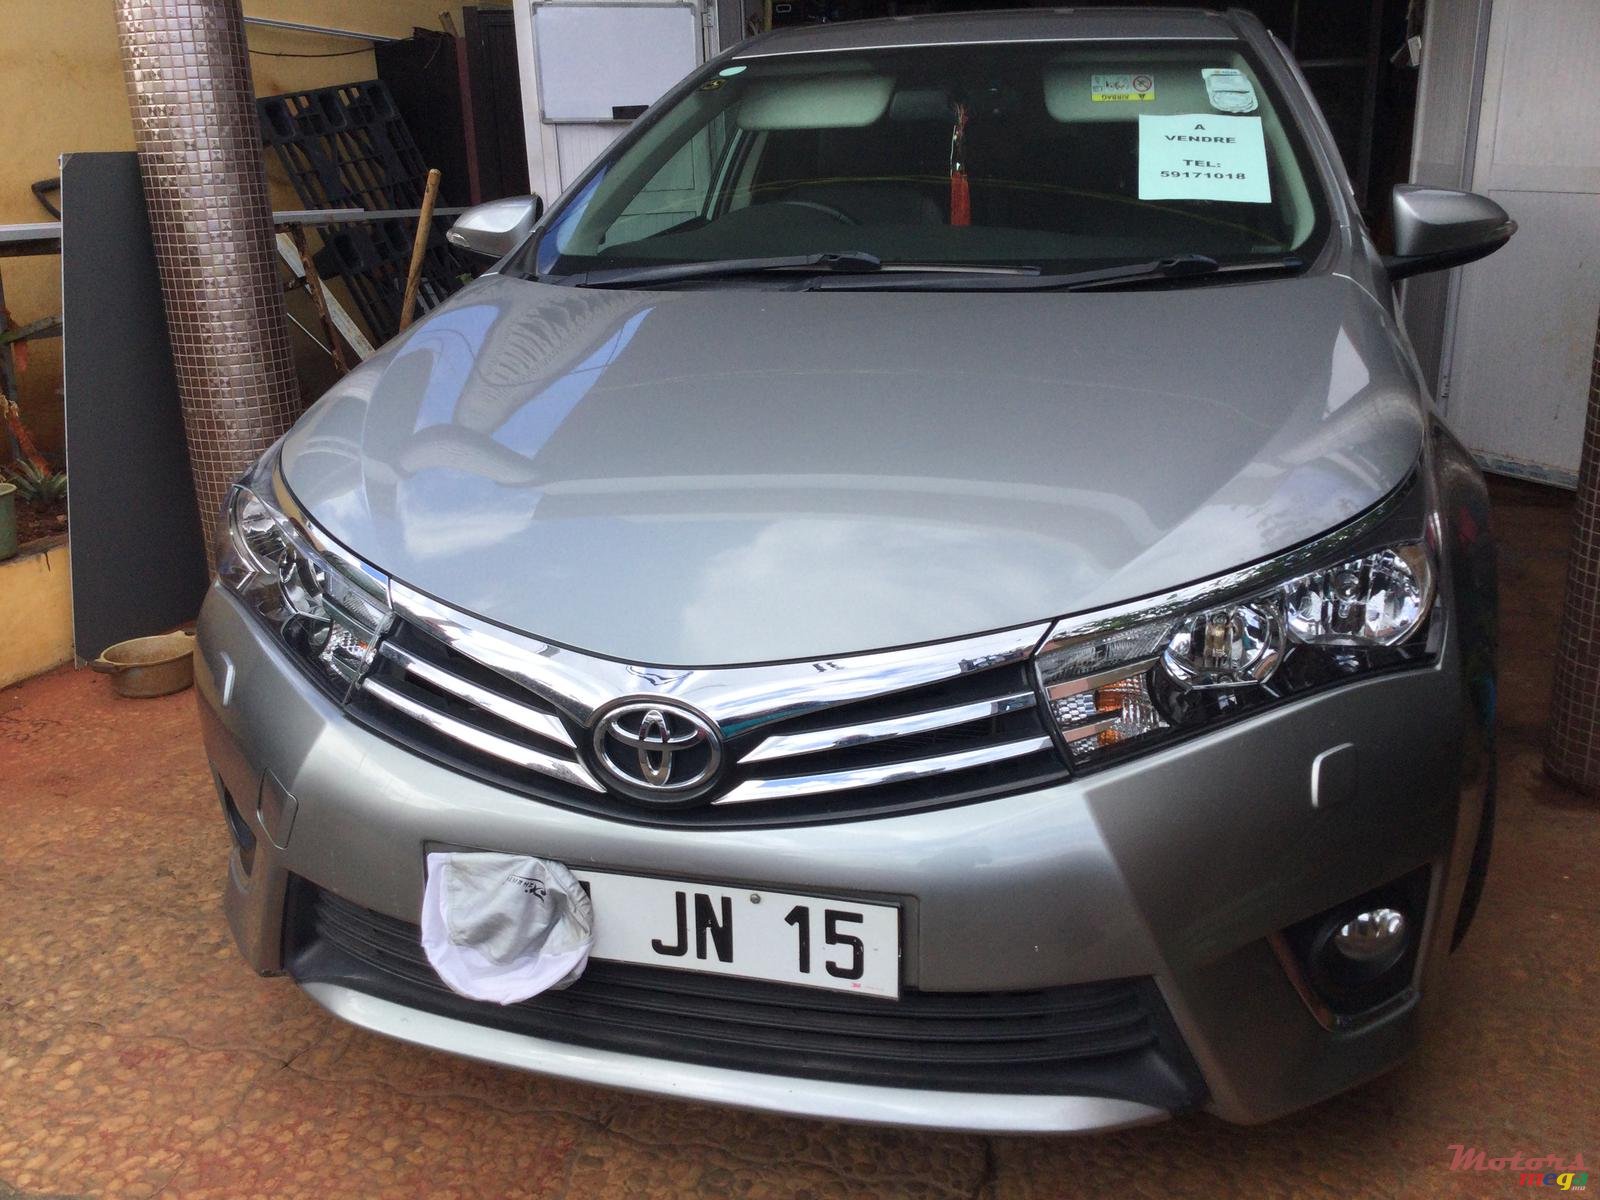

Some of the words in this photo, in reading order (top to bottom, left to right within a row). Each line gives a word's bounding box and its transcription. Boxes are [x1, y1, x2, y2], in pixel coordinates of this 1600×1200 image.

[1165, 135, 1237, 144] VENDRE
[1183, 159, 1221, 168] TEL:
[1160, 171, 1246, 180] 59171018
[651, 890, 734, 964] JN
[784, 905, 865, 981] 15
